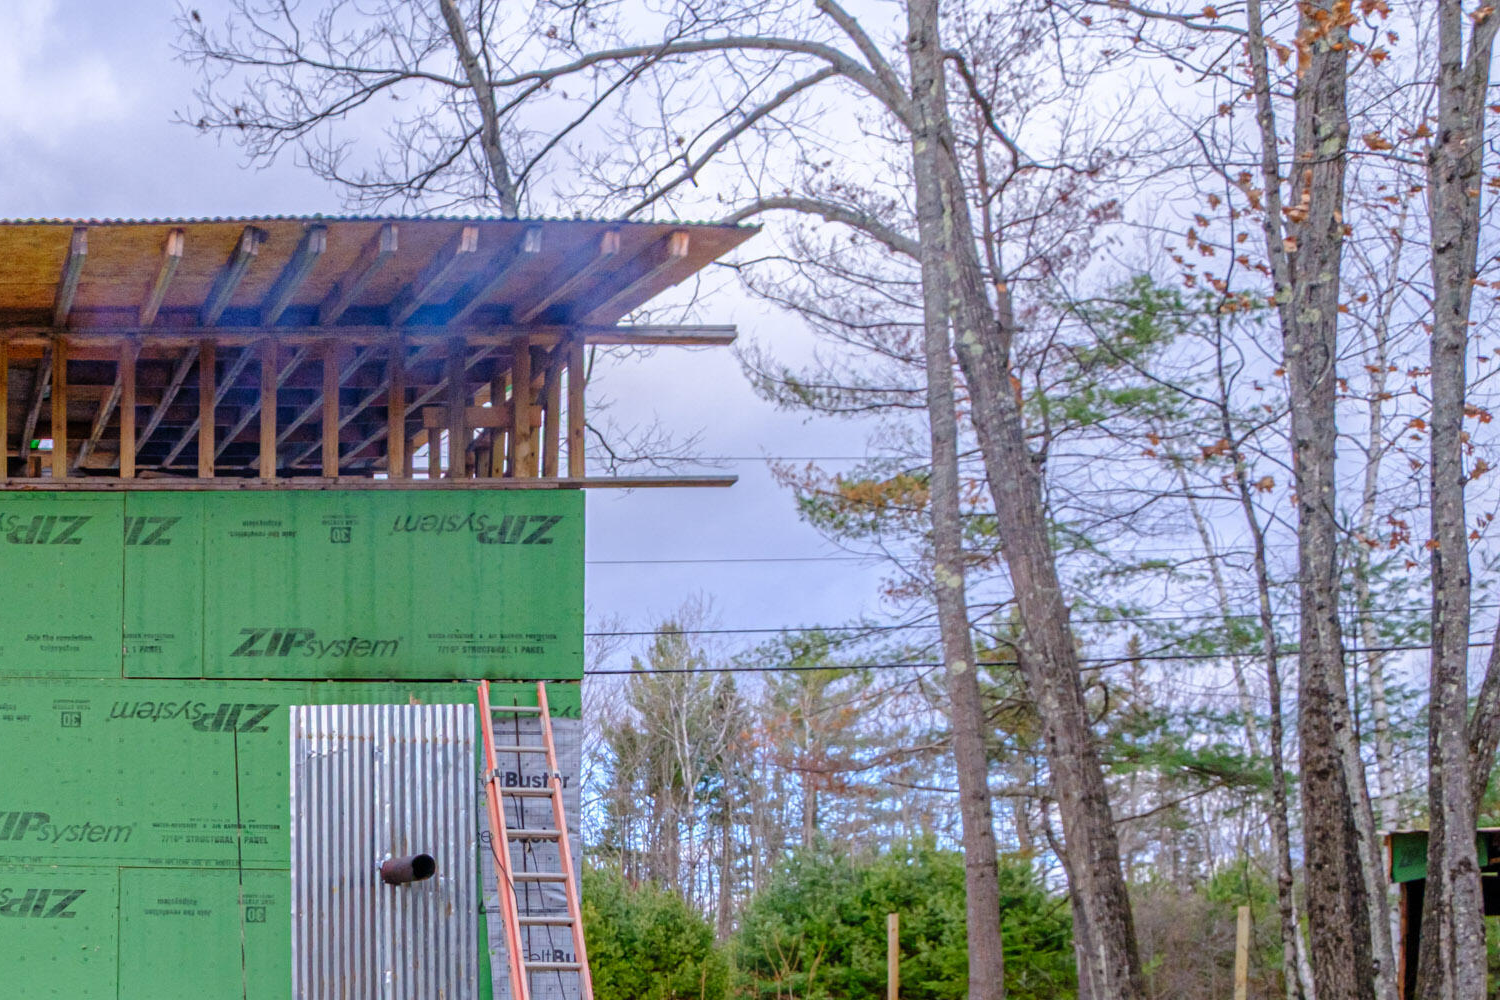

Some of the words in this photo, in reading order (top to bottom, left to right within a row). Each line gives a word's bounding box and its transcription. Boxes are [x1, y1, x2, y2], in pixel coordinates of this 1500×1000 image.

[124, 515, 182, 545] ZI
[393, 511, 564, 544] ZIPsystem
[332, 529, 349, 542] 30
[139, 646, 164, 654] PANEL
[229, 628, 400, 661] ZIPsystem
[521, 646, 545, 654] PANEL
[63, 713, 80, 726] 30
[110, 700, 280, 732] ZIPsystem
[244, 836, 268, 844] PANEL
[247, 908, 264, 921] 30
